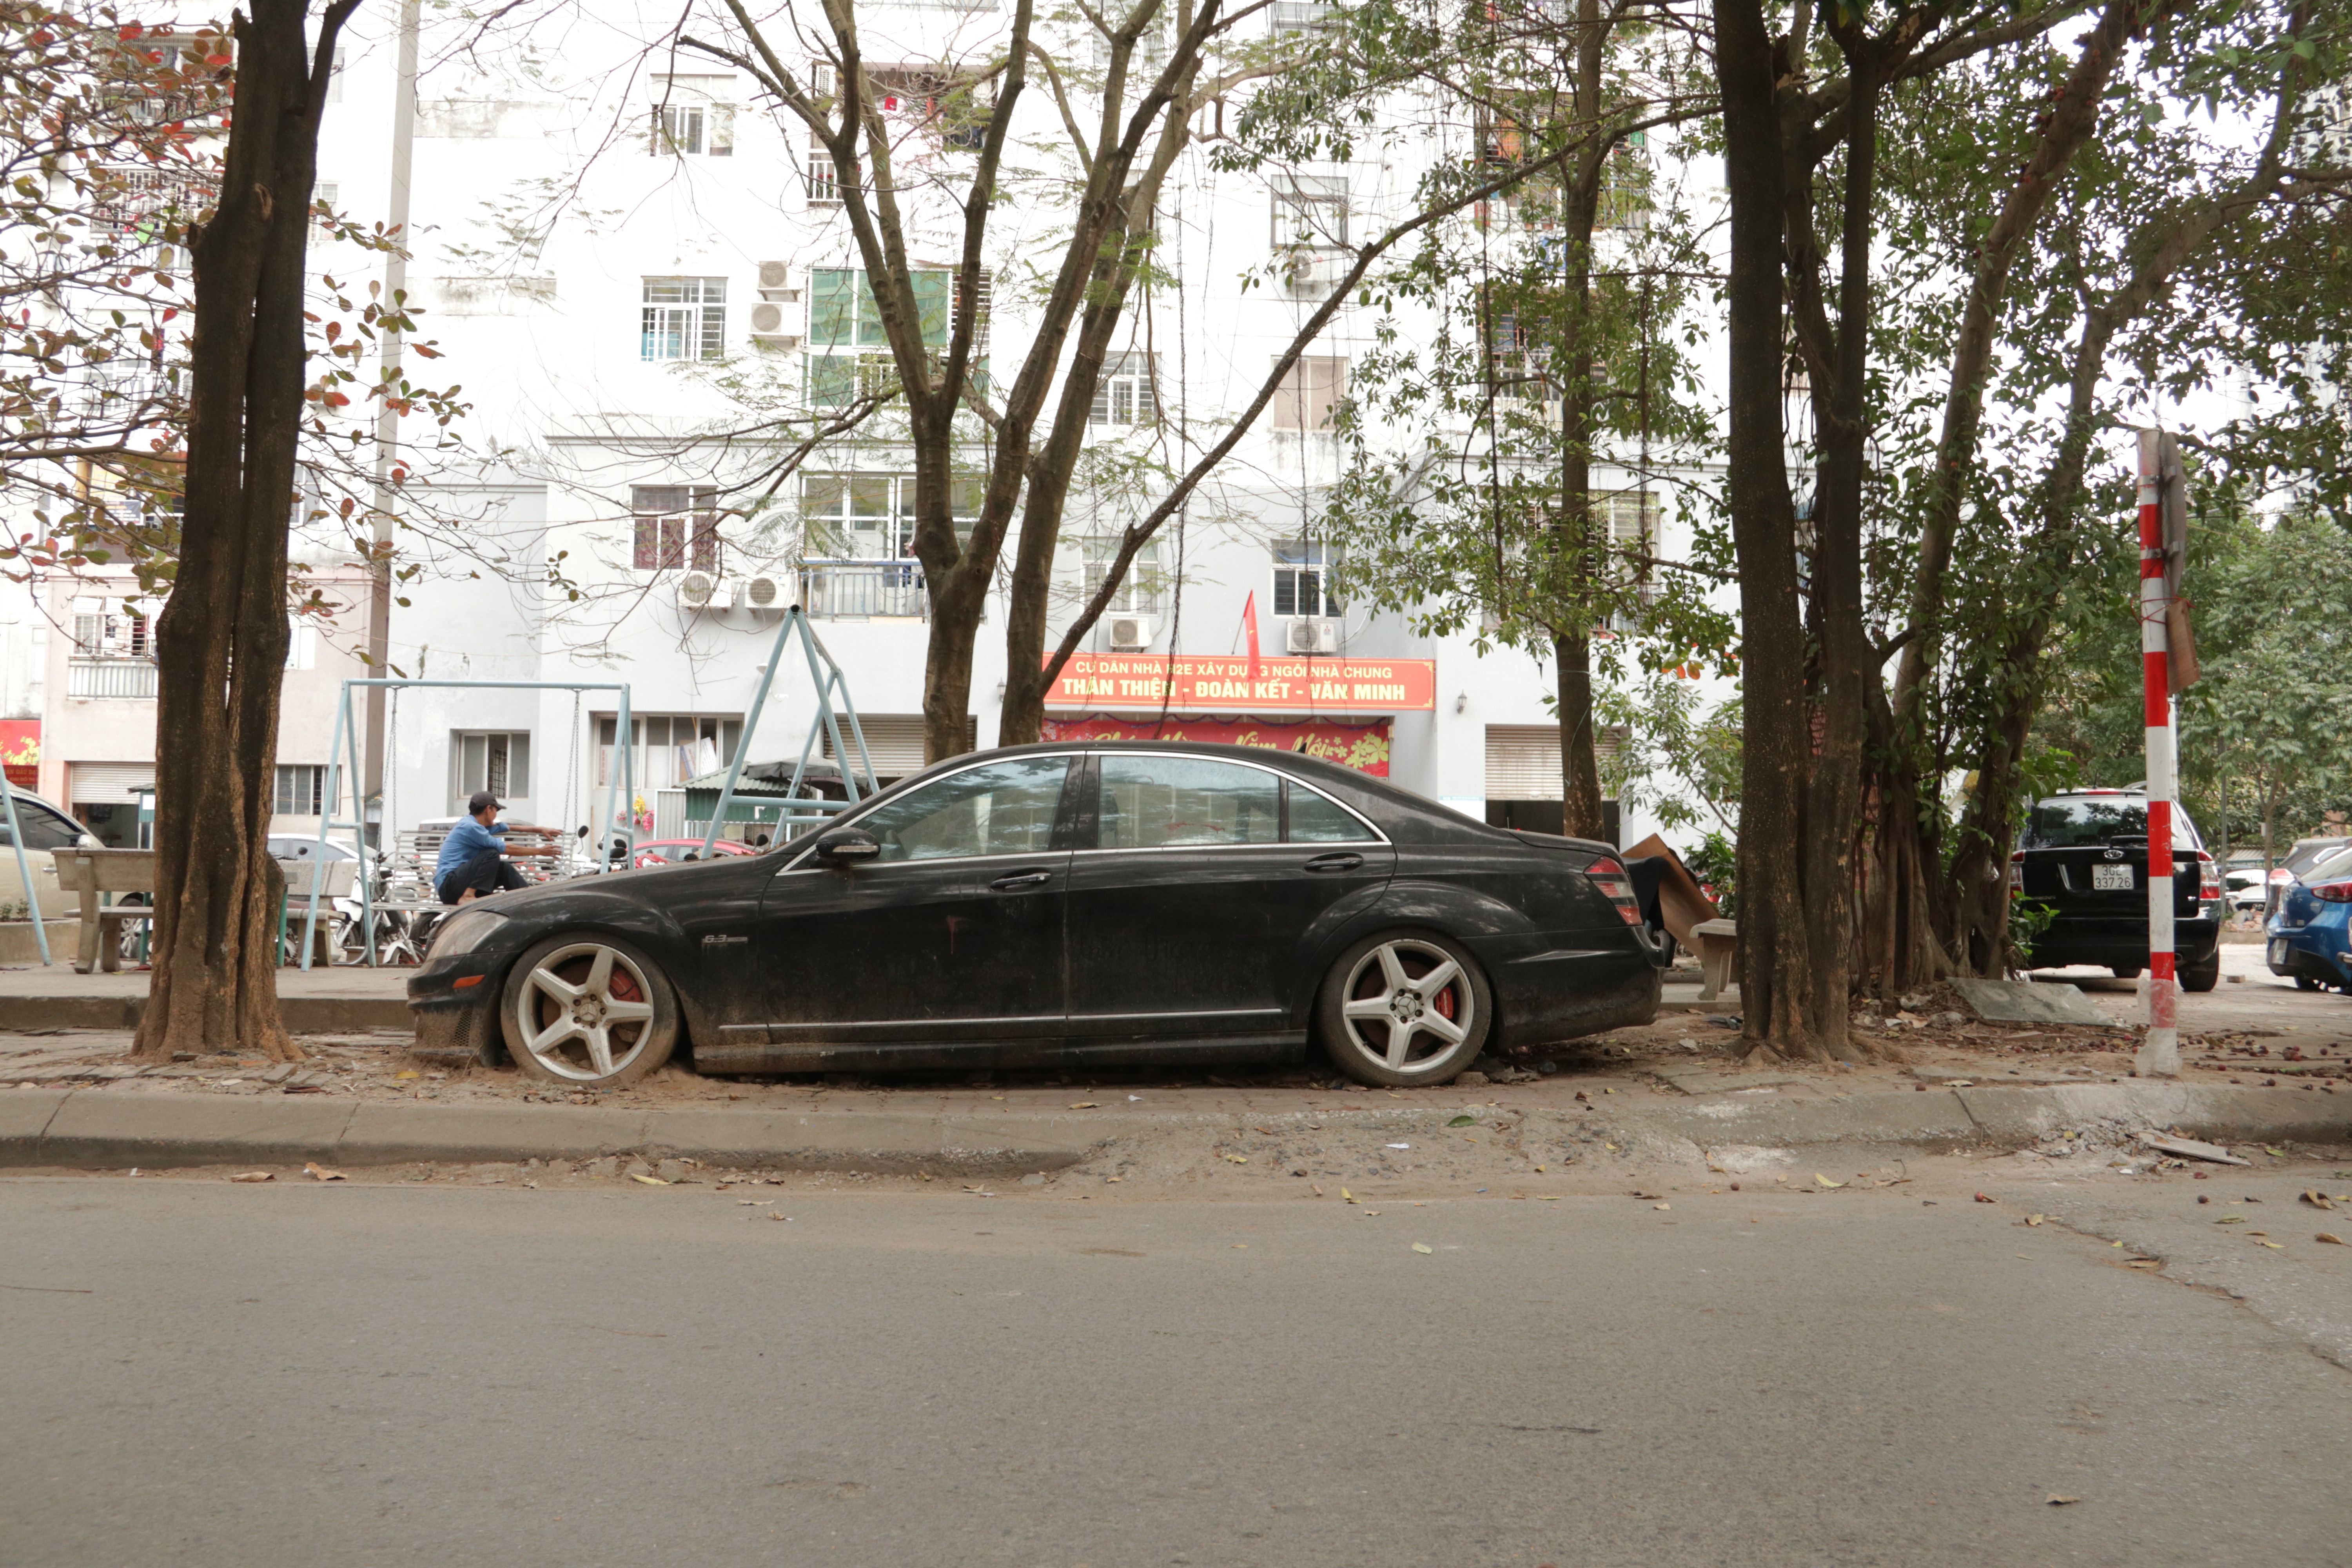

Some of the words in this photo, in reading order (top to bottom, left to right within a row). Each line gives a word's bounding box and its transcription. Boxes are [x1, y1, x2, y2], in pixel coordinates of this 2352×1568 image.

[1076, 661, 1096, 673] CƯ
[1100, 660, 1128, 673] DÂN
[1133, 661, 1162, 674] NHÀ
[1197, 662, 1224, 675] XÂY
[1229, 663, 1268, 678] DỰG
[1273, 663, 1306, 677] NGÔI
[1311, 664, 1339, 678] NHÀ
[1343, 666, 1392, 679] CHUNG
[1062, 675, 1114, 695] THÂN
[1119, 677, 1176, 700] THIỆN
[1195, 679, 1249, 698] ĐOÀN
[1255, 678, 1290, 699] KẾT
[1310, 680, 1348, 700] VĂN
[1354, 684, 1405, 700] MINH
[2095, 877, 2131, 888] 337.26
[705, 934, 727, 943] 6.3
